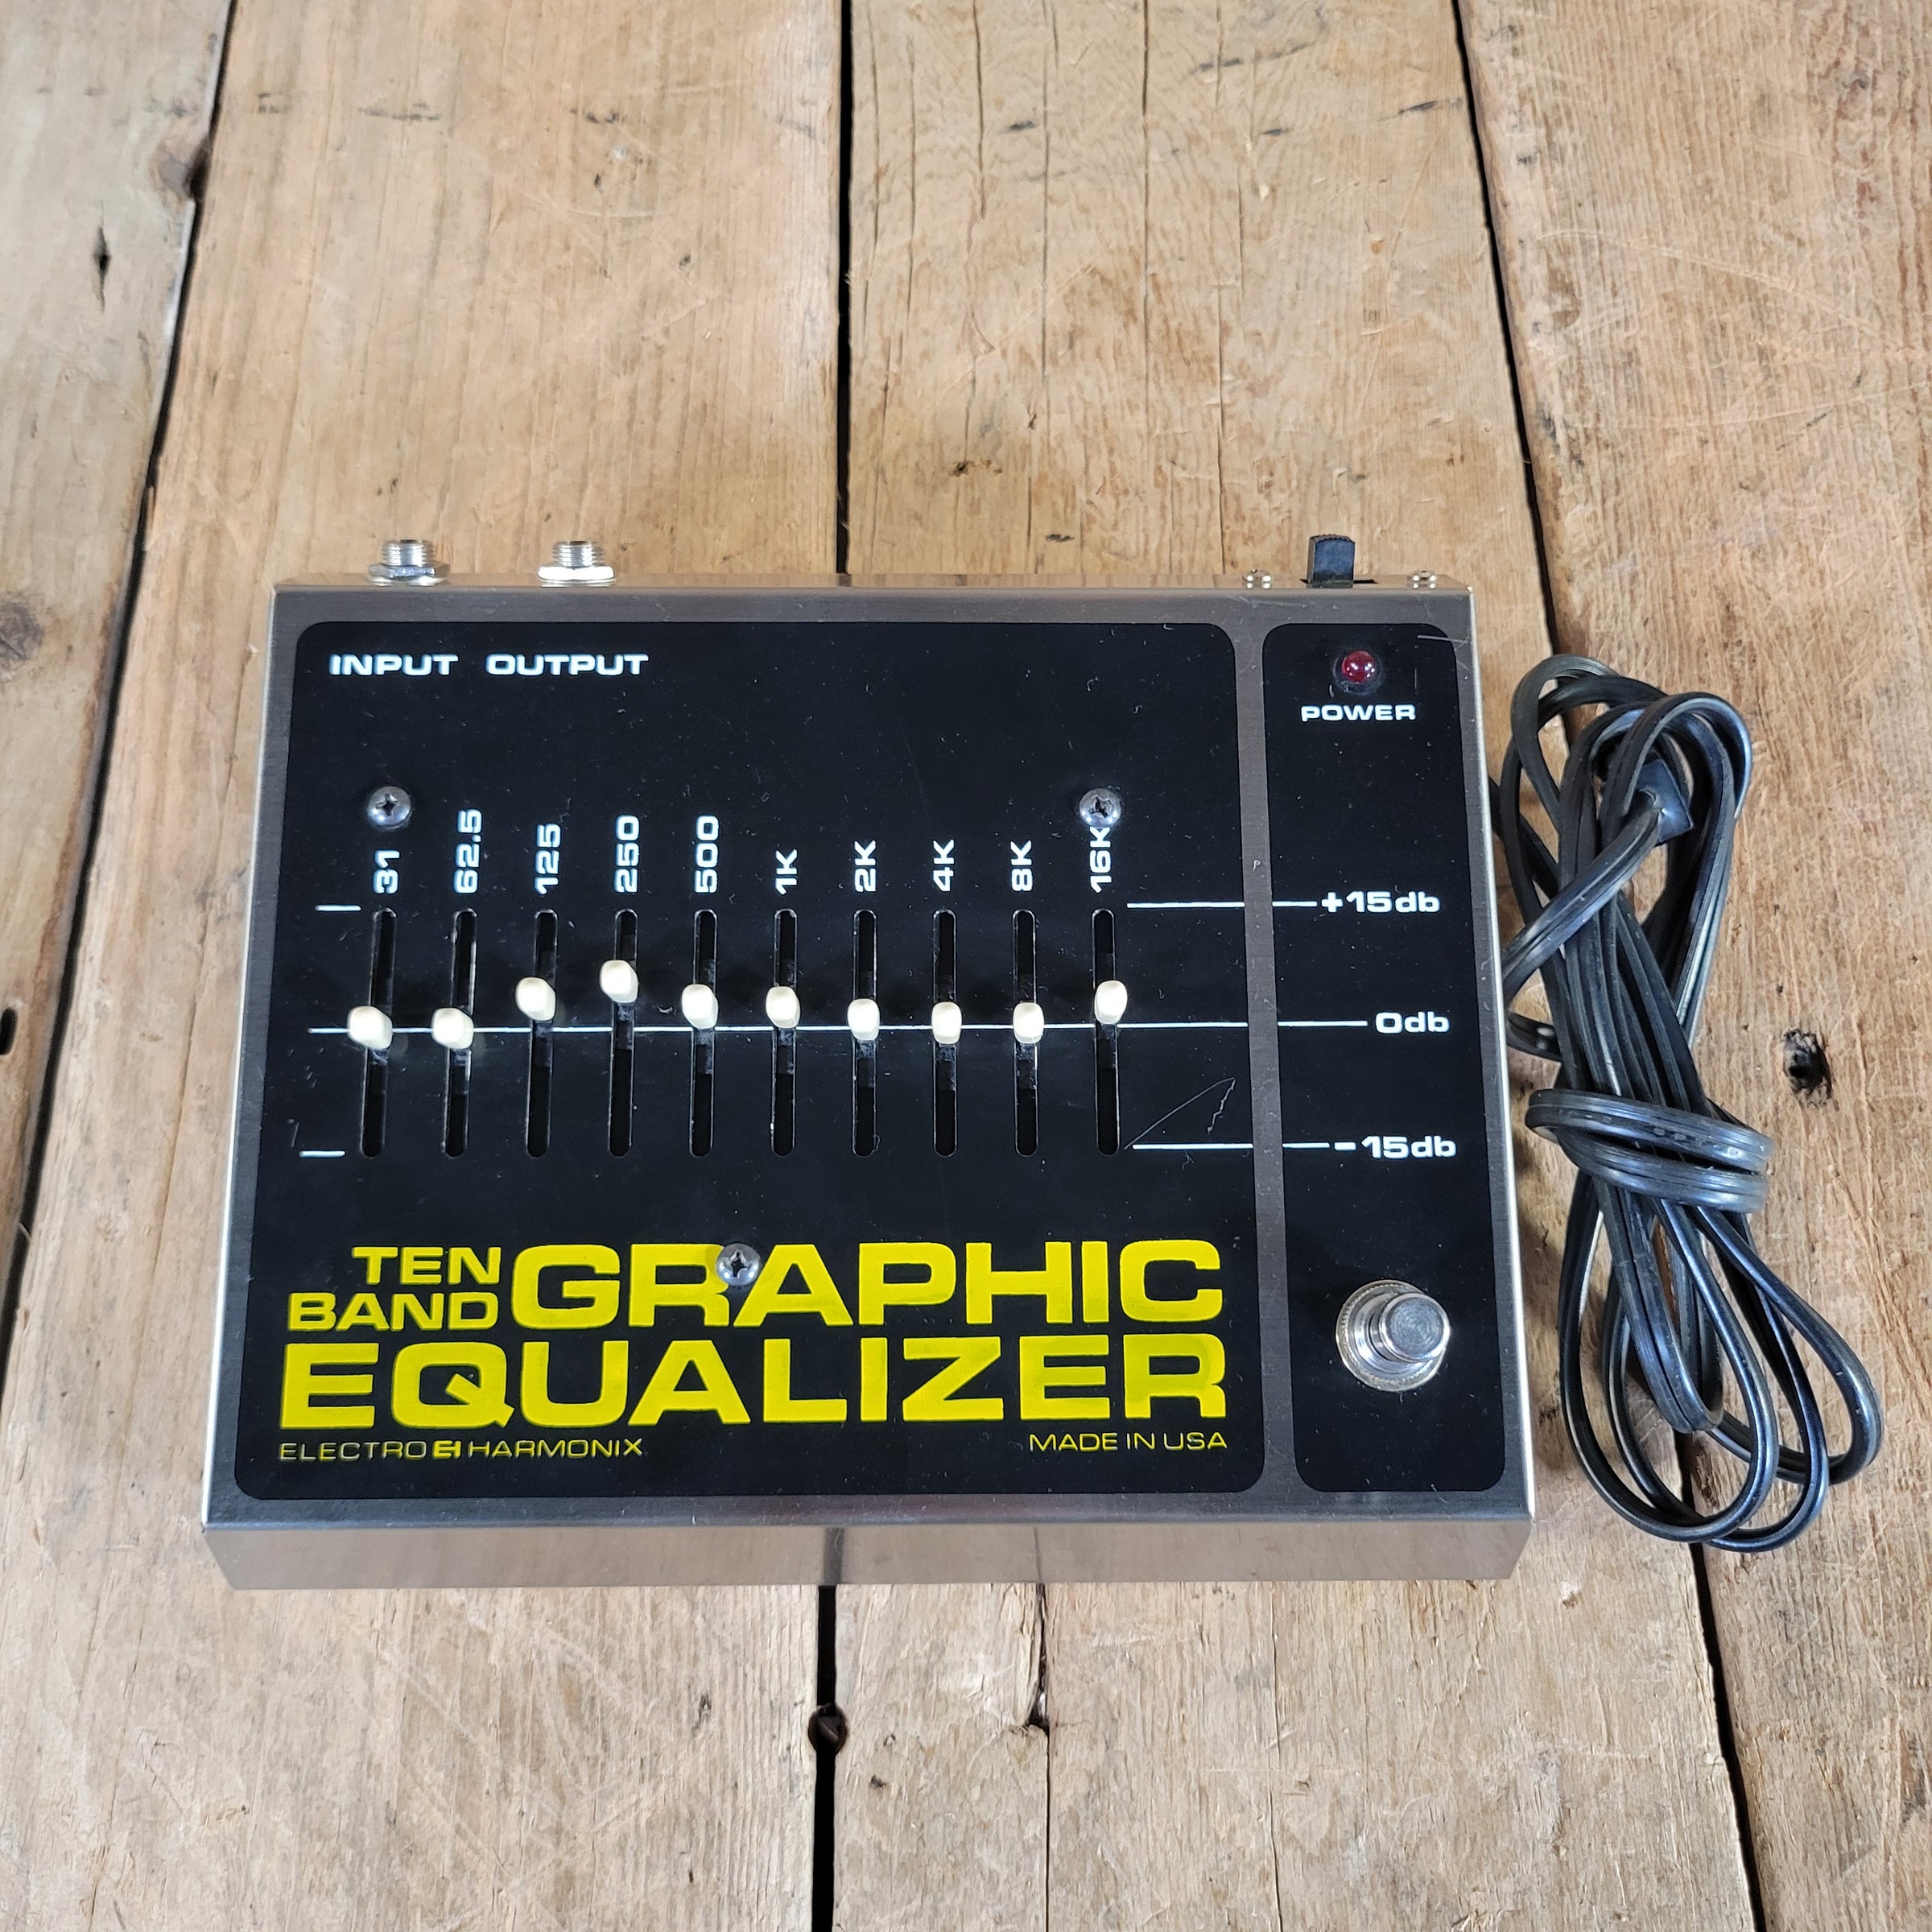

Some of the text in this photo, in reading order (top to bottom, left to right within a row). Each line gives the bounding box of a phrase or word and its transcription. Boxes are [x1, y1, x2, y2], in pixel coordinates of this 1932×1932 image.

[329, 654, 458, 675] INPUT
[485, 654, 649, 675] OUTPUT
[1301, 704, 1416, 721] POWER
[374, 850, 399, 894] 31
[453, 809, 482, 893] 62.5
[535, 824, 560, 894] 125
[614, 815, 639, 892] 250
[695, 815, 719, 893] 500
[775, 849, 797, 894] 1K
[854, 840, 876, 892] 2K
[933, 840, 954, 891] 4K
[1010, 840, 1032, 891] 8K
[1089, 827, 1112, 893] 16K
[1322, 891, 1440, 912] +15db
[1376, 1011, 1450, 1034] 0db
[1334, 1136, 1456, 1158] -15db
[352, 1247, 501, 1284] TEN
[511, 1240, 1222, 1329] GRAPHIC
[288, 1292, 498, 1331] BAND
[280, 1333, 1226, 1428] EQUALIZER
[280, 1442, 426, 1460] ELECTRO
[469, 1439, 642, 1457] HARMONIX
[1030, 1432, 1227, 1451] MADE IN USA
